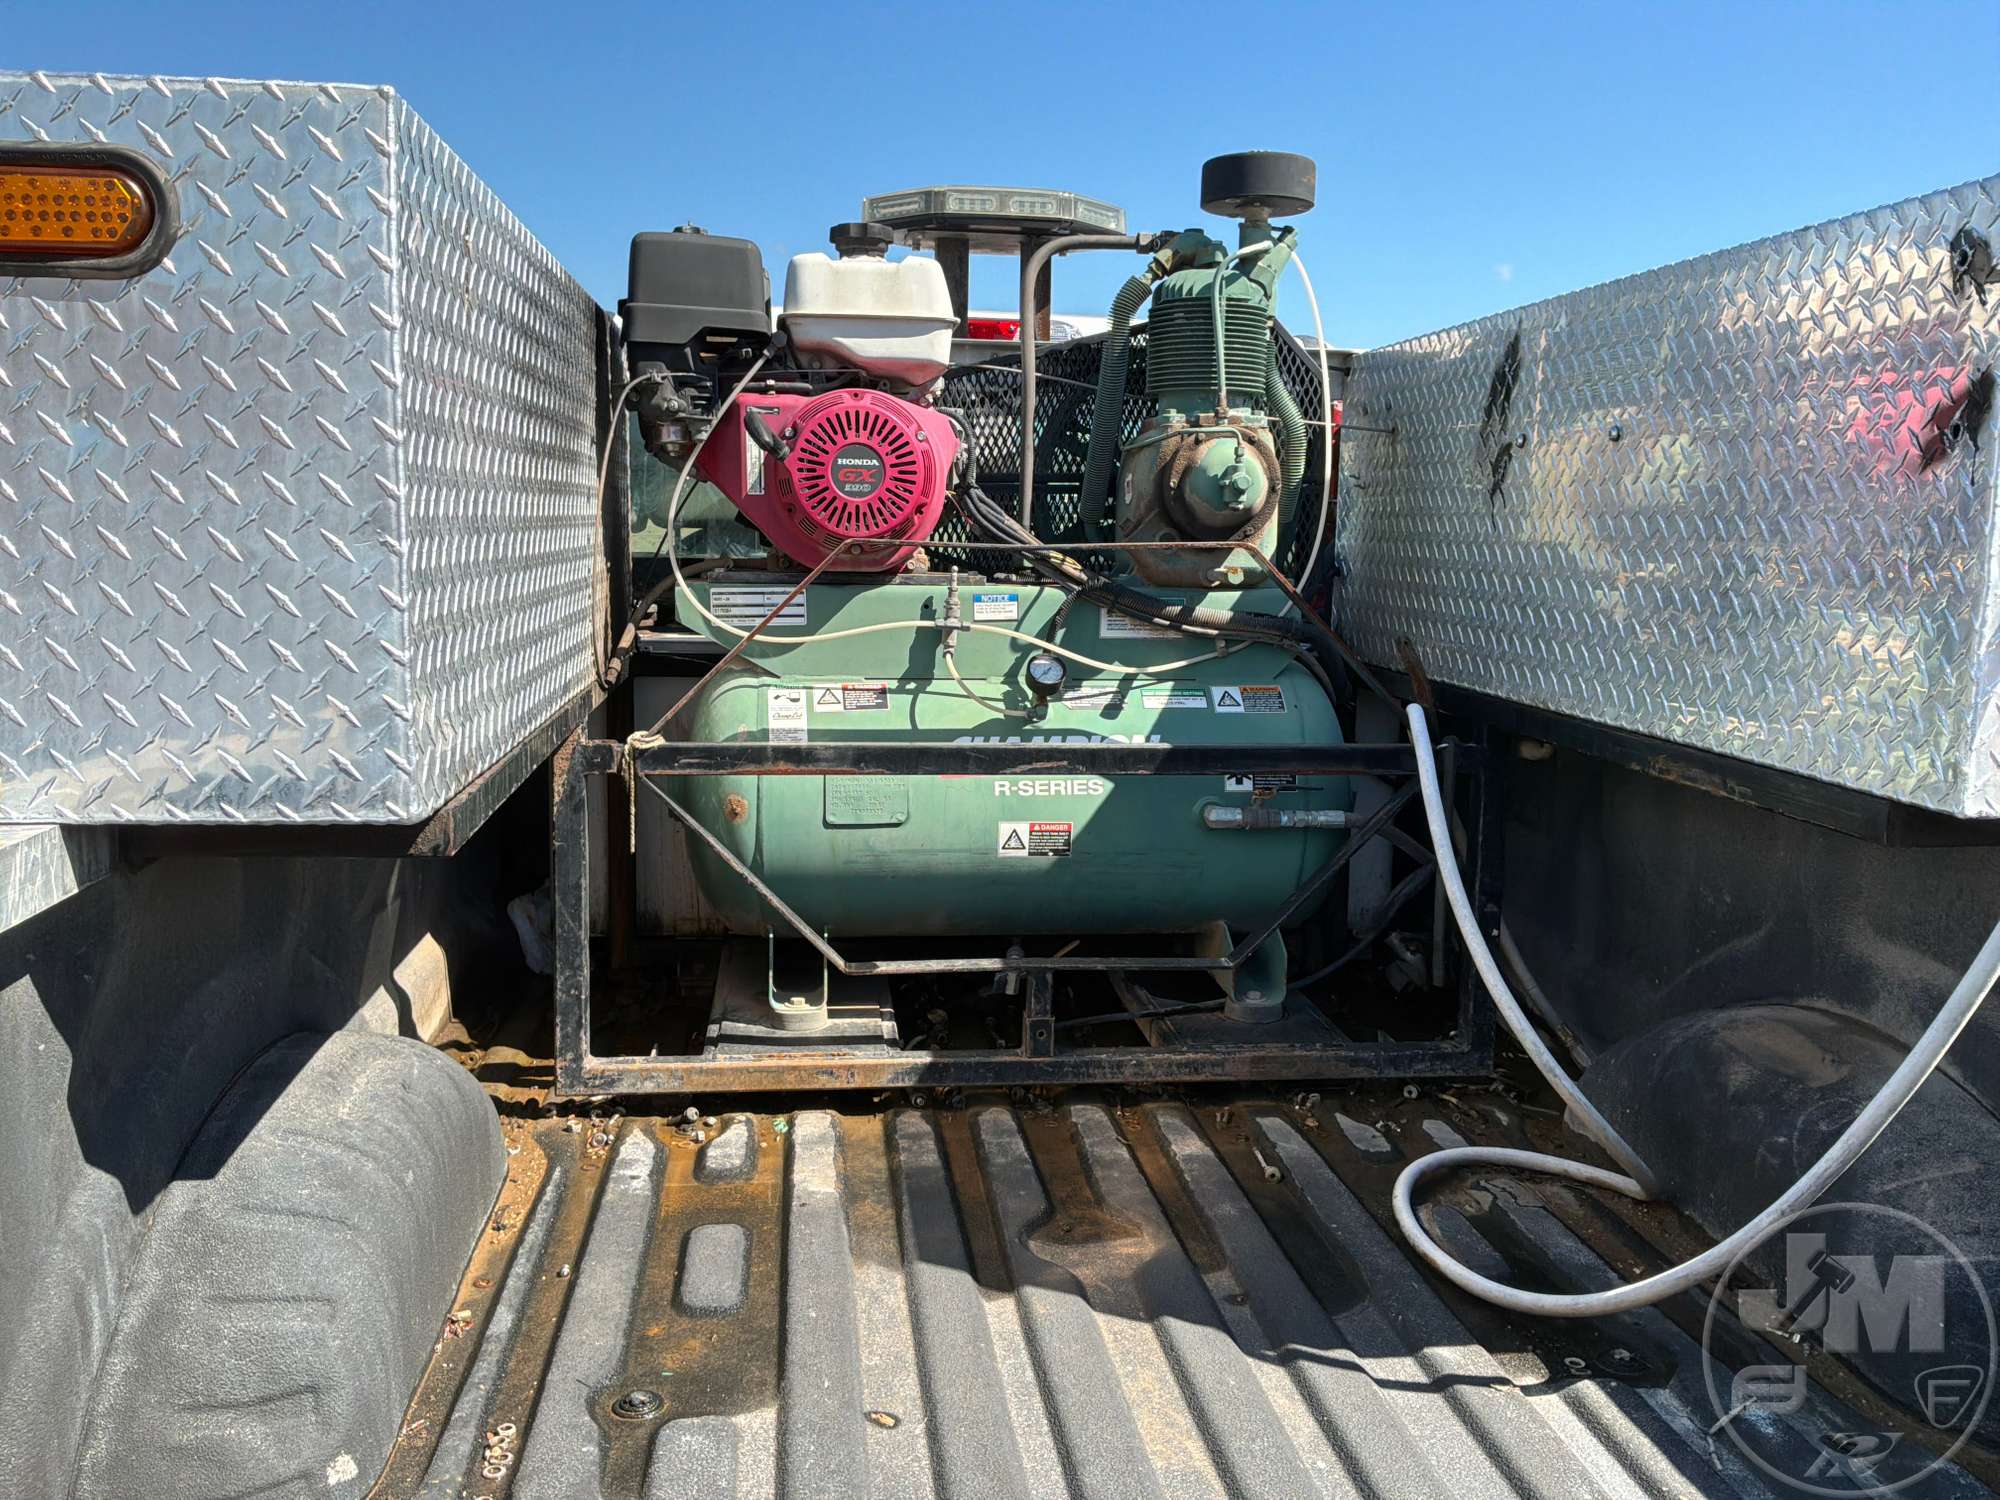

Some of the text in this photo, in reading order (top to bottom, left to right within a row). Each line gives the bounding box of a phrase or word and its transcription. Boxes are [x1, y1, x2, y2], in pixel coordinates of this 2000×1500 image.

[839, 468, 879, 482] GX
[981, 594, 1008, 602] NOTICE
[994, 780, 1104, 796] R-SERIES
